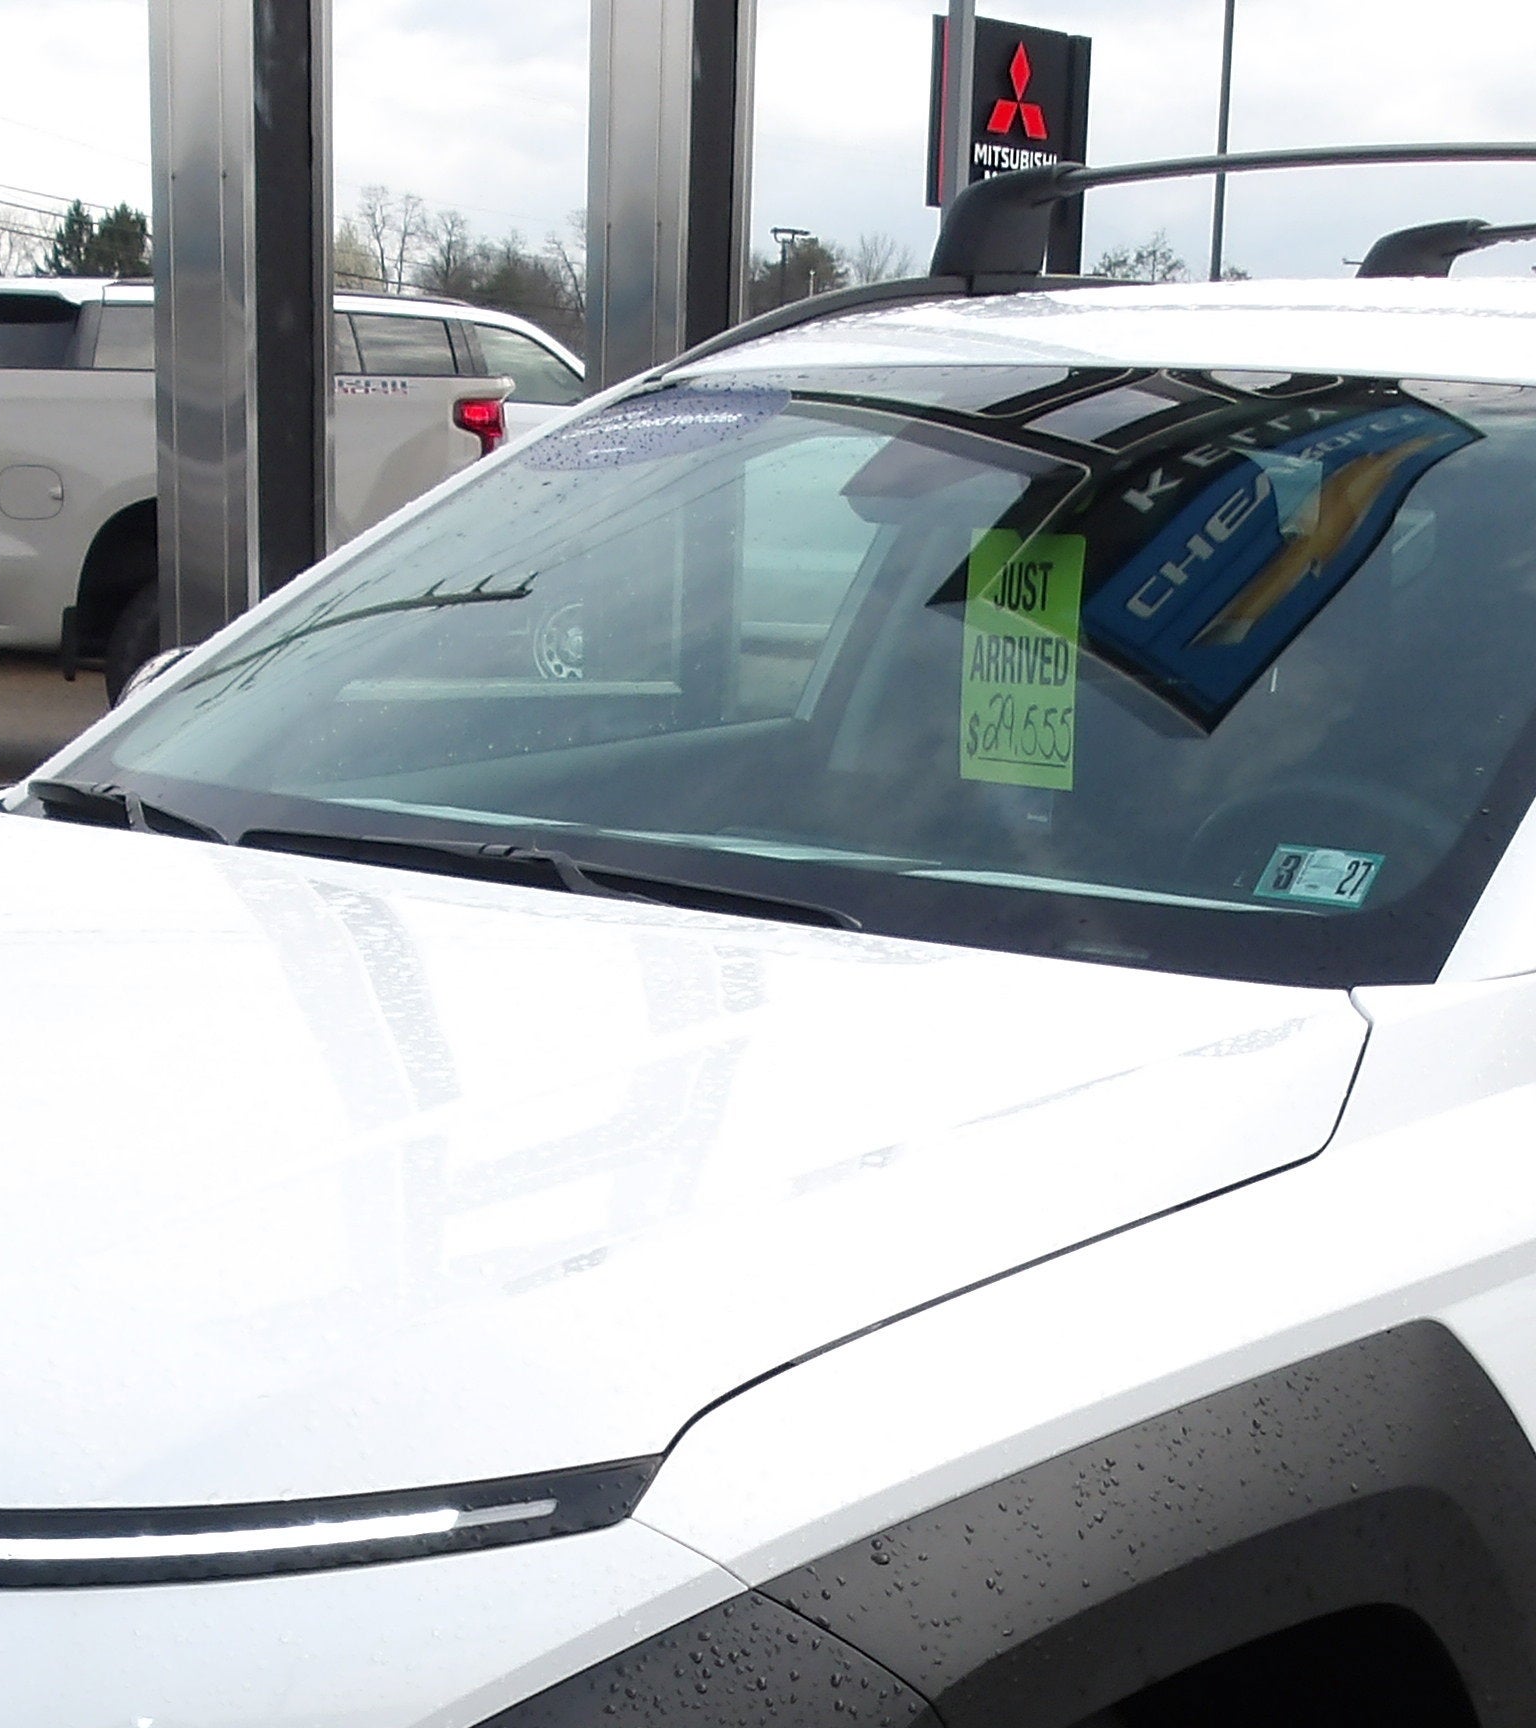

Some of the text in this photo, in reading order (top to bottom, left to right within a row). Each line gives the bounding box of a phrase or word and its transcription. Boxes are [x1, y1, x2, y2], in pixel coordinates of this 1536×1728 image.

[974, 143, 1057, 170] MITSUBISHI
[994, 561, 1053, 612] JUST
[970, 634, 1069, 686] ARRIVED
[1273, 855, 1302, 890] 3
[1335, 860, 1374, 896] 27
